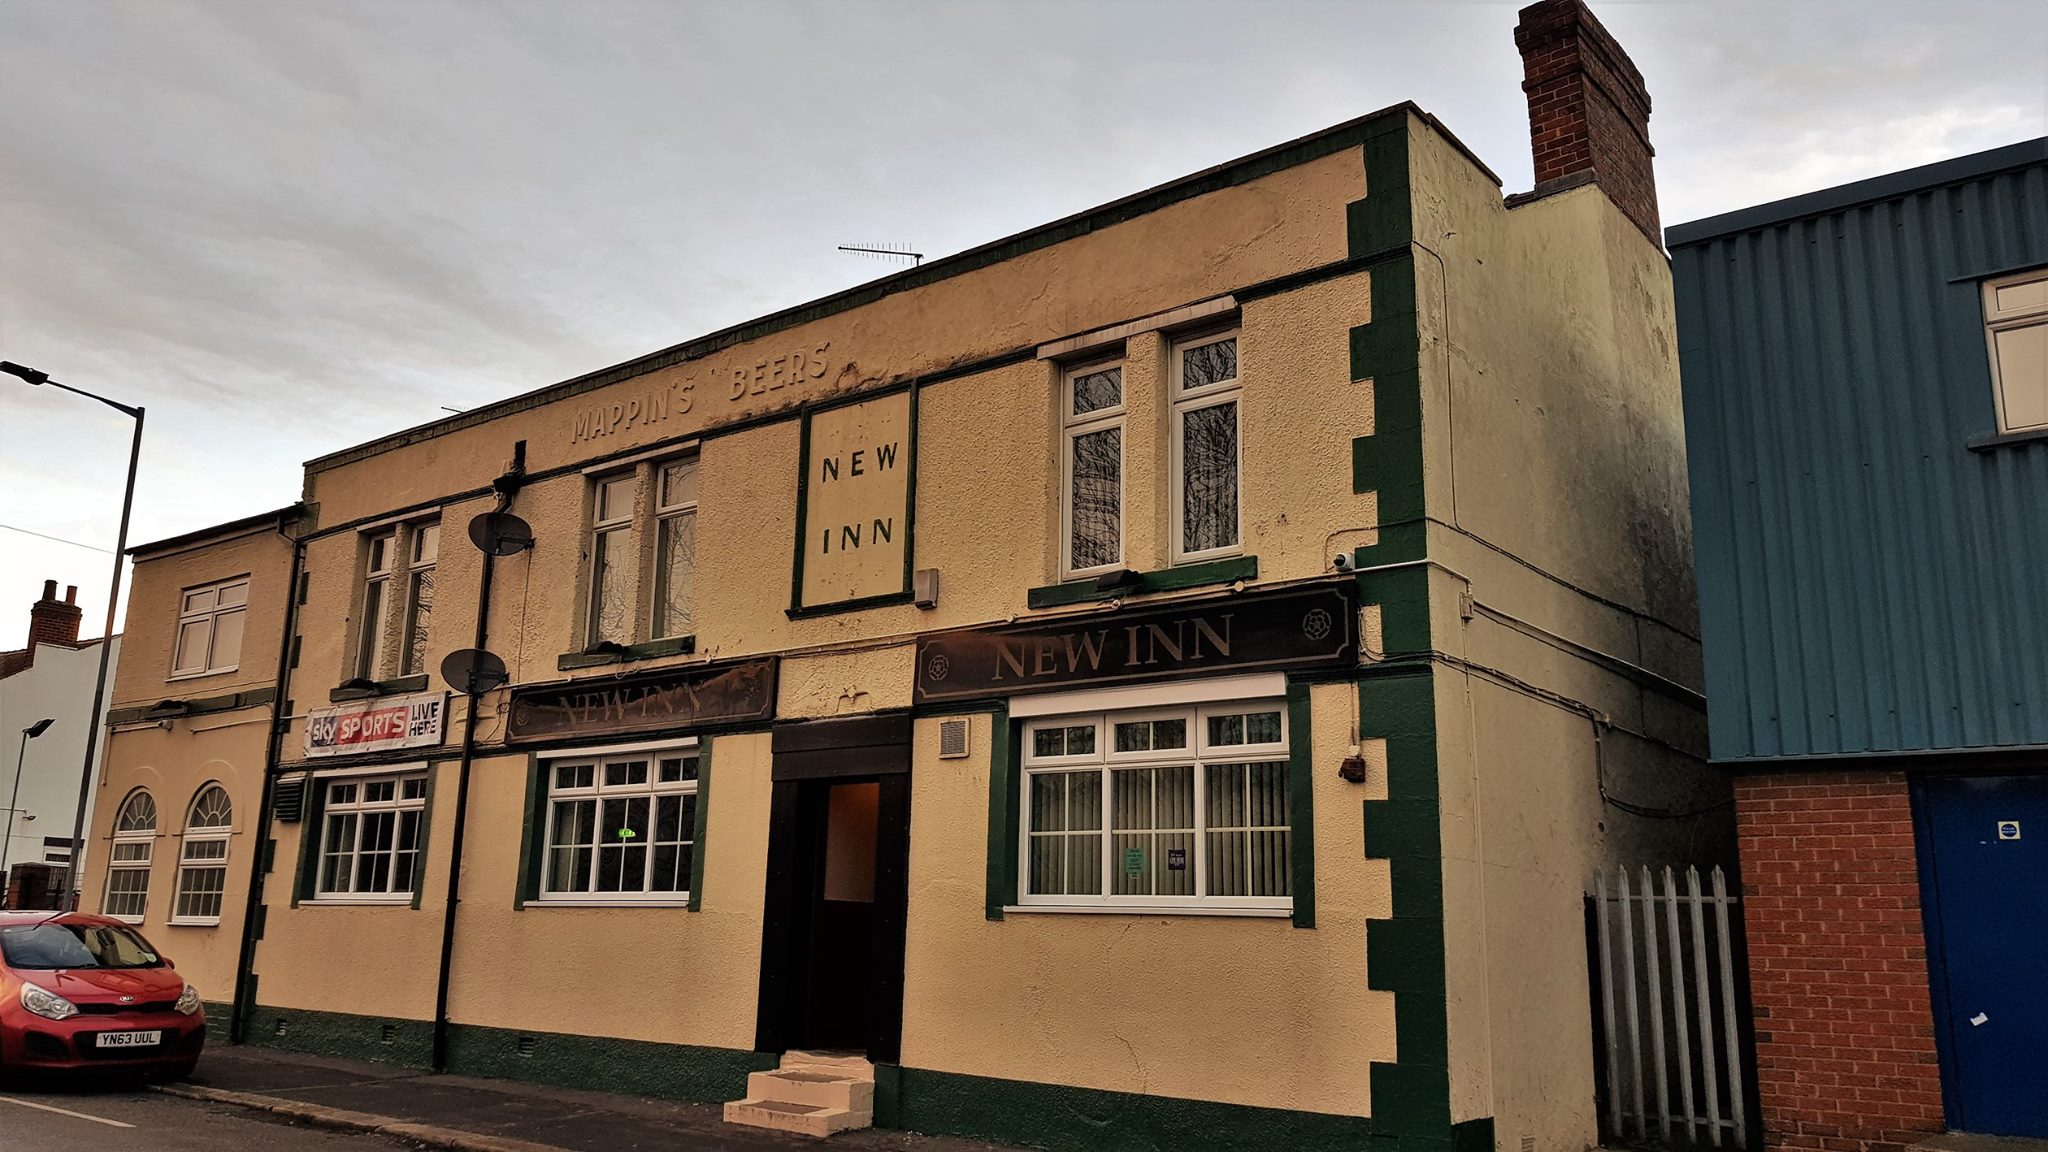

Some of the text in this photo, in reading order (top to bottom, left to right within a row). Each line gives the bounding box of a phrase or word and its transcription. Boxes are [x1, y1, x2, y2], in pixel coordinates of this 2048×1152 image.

[571, 341, 831, 444] MAPPIN'S BEERS
[822, 442, 898, 483] NEW
[823, 517, 892, 554] INN
[991, 613, 1235, 680] NEW INN
[411, 702, 440, 721] LIVE
[558, 680, 703, 727] NEW INN
[312, 711, 406, 744] sky SPORTS
[408, 719, 438, 737] HERE
[102, 1032, 156, 1045] YN63 UUL
